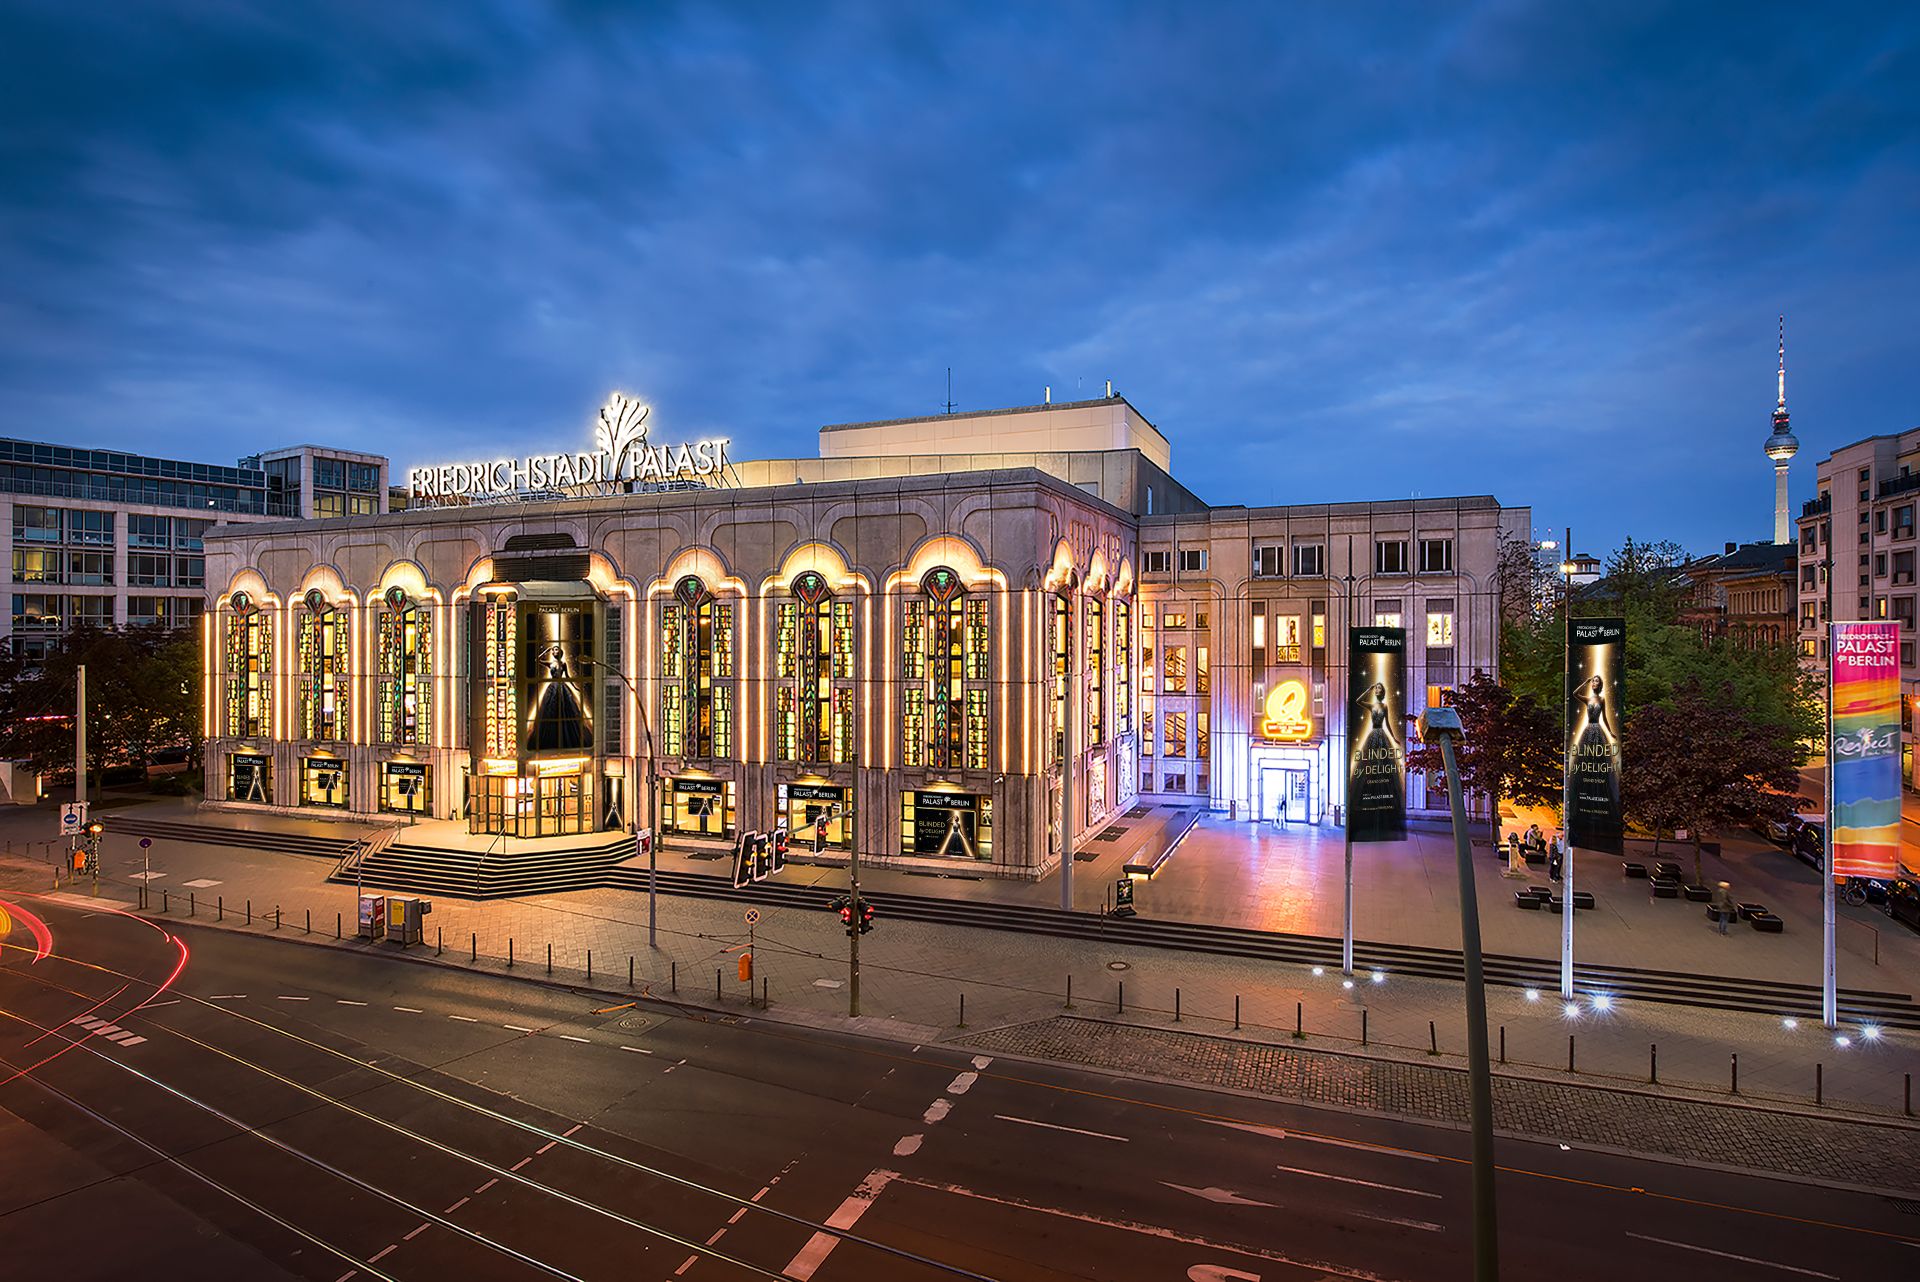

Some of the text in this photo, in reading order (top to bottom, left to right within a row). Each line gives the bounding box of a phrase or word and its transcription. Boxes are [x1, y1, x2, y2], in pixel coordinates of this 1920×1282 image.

[408, 438, 731, 499] FRIEDRICHSTADT PALAST
[1576, 629, 1620, 638] PALAST BERLIN
[1384, 639, 1401, 647] BERLIN
[1836, 640, 1895, 653] PALAST
[1848, 655, 1895, 667] BERLIN
[1834, 727, 1898, 757] Respect
[1354, 747, 1403, 761] BLINDED
[1571, 743, 1620, 757] BLINDED
[1354, 763, 1405, 778] by DELIGHT
[1571, 761, 1619, 774] by DELIGHT
[918, 820, 946, 828] BLINDED
